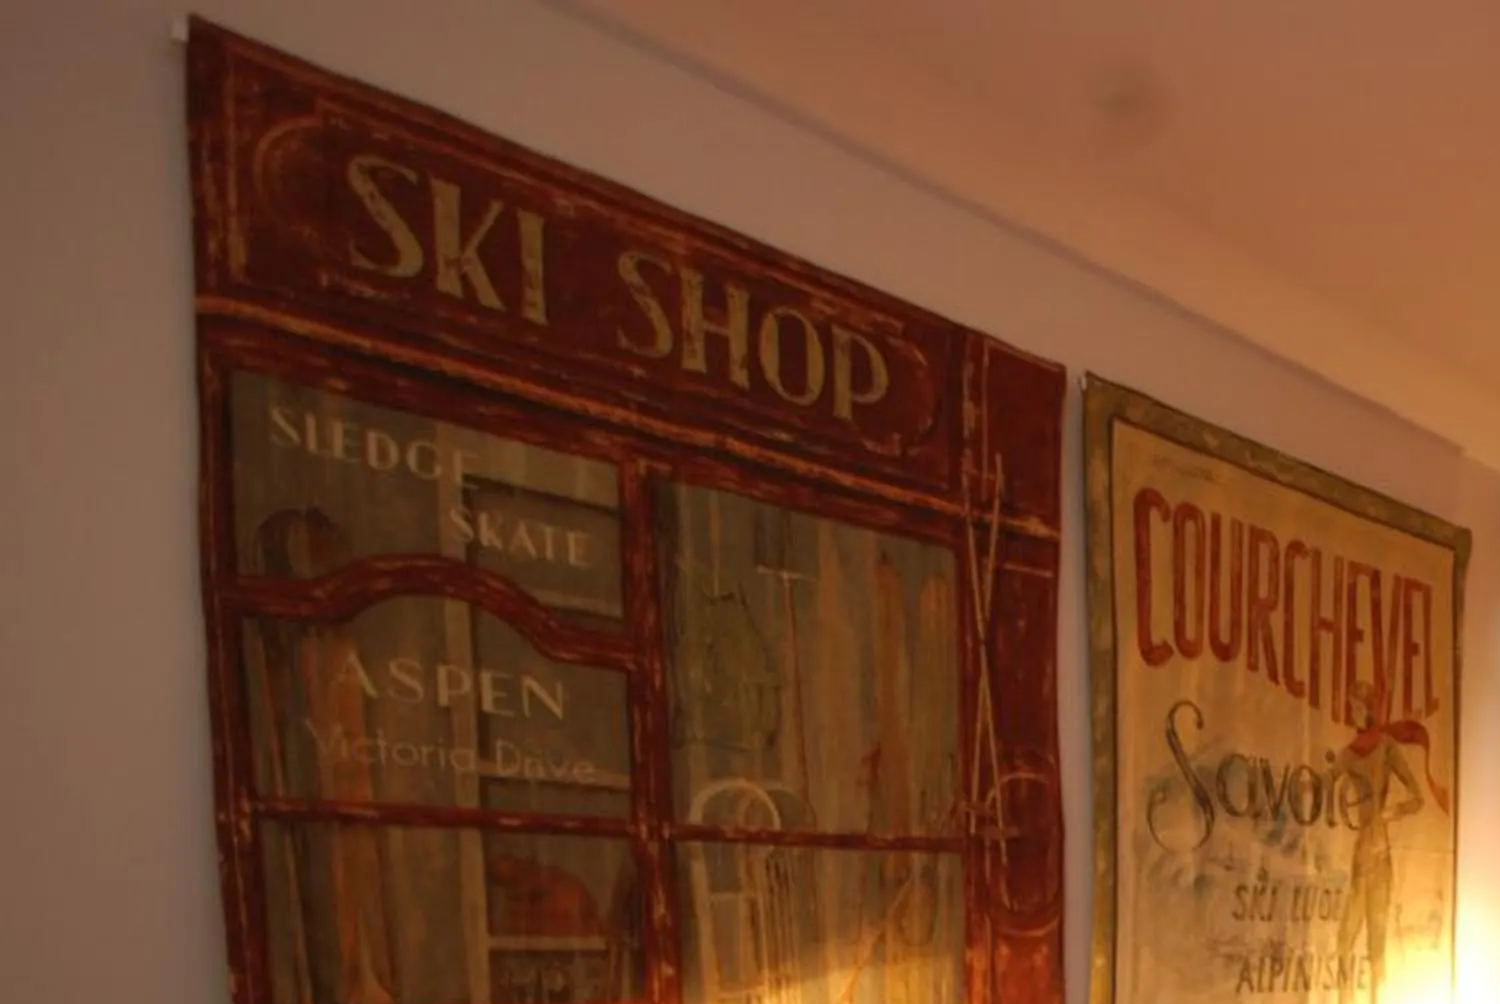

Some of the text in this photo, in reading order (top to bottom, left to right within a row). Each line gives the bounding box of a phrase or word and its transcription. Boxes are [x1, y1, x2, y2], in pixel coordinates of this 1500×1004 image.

[346, 155, 892, 420] SKI SHOP
[269, 401, 480, 490] SLEDGE
[447, 506, 591, 570] SKATE
[1132, 487, 1440, 727] COURCHEVEL
[333, 645, 566, 722] ASPEN
[305, 717, 597, 784] Victoria Drive
[1147, 698, 1373, 855] Savoie
[1231, 883, 1279, 922] SKI
